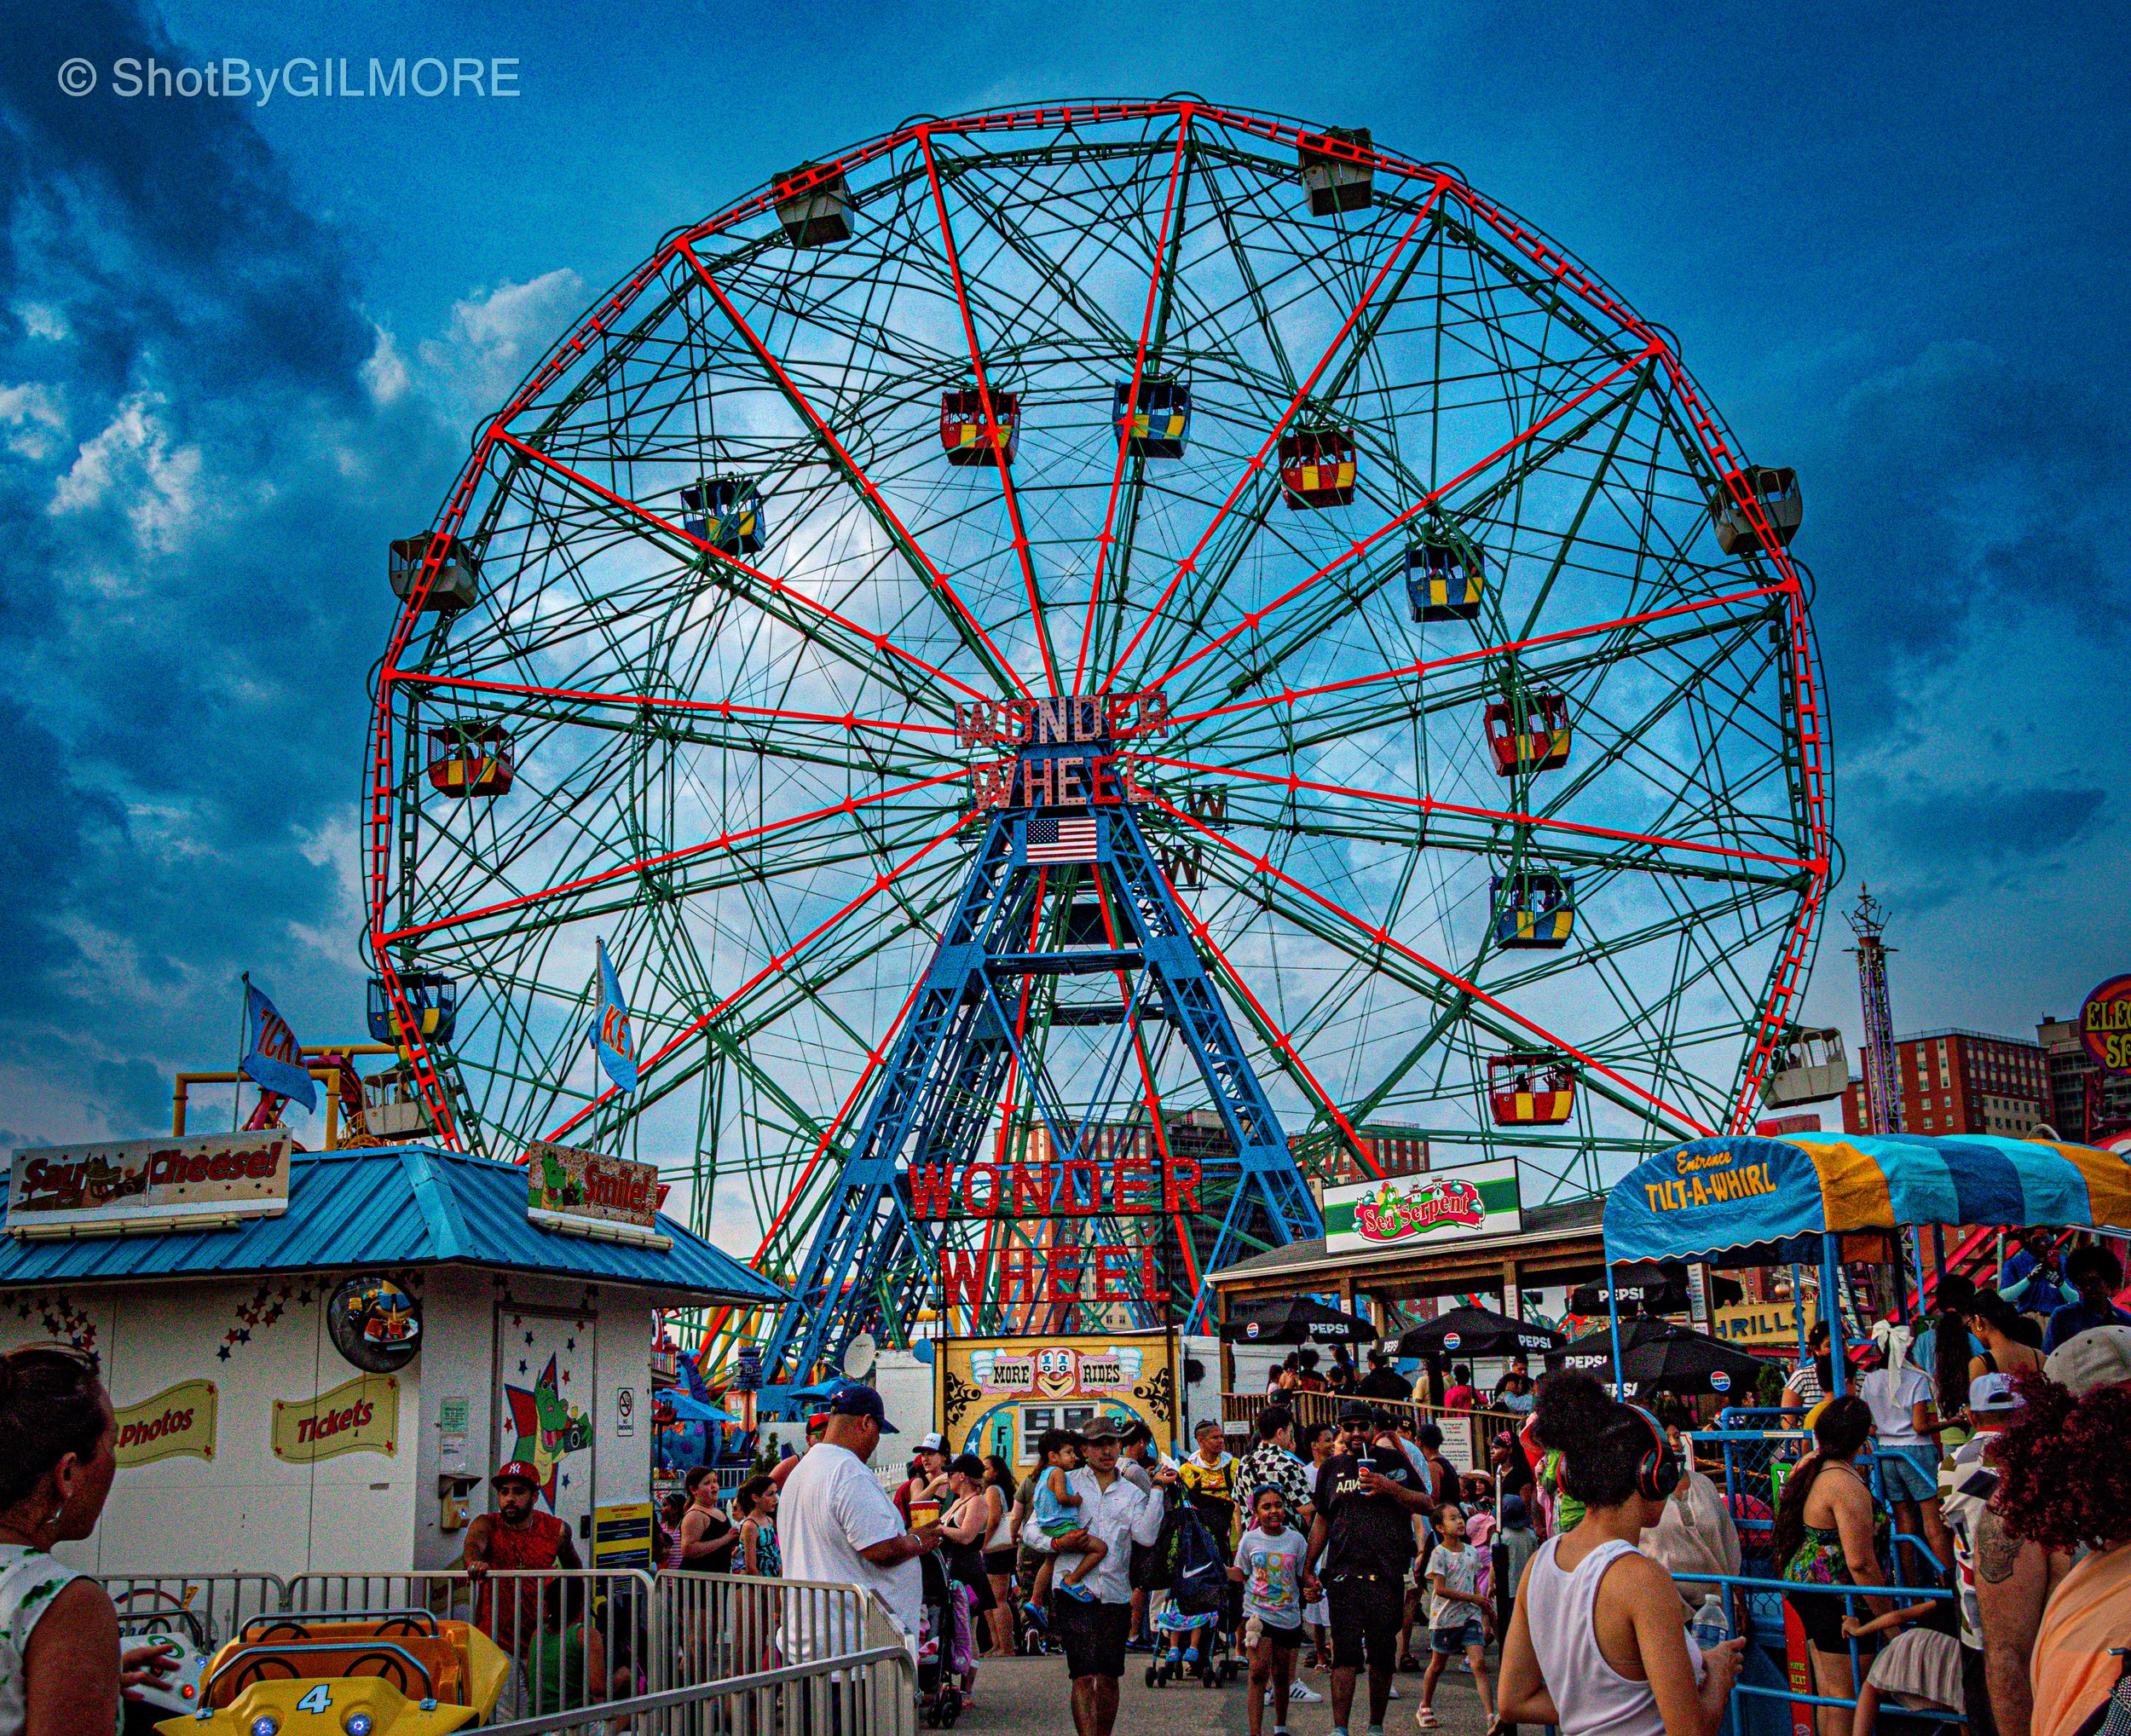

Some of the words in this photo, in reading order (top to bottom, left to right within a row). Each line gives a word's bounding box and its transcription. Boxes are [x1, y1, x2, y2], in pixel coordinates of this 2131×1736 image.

[955, 691, 1168, 748] WONDER
[970, 754, 1156, 810] WHEEL
[20, 1157, 87, 1197] Say
[145, 1141, 283, 1185] Cheese!
[1676, 1151, 1732, 1174] Entrance
[583, 1161, 650, 1213] Smile!
[908, 1156, 1203, 1220] WONDER
[1644, 1162, 1777, 1213] TILT-A-WHIRL
[1364, 1209, 1396, 1232] Sea
[1399, 1191, 1470, 1227] Serpent
[938, 1245, 1171, 1306] WHEEL
[1309, 1324, 1349, 1335] PEPSI
[1518, 1334, 1552, 1349] PEPSI
[993, 1364, 1030, 1384] MORE
[1083, 1364, 1120, 1383] RIDES
[118, 1407, 194, 1448] Photos
[297, 1399, 373, 1444] Tickets
[508, 1462, 521, 1474] NY
[296, 1683, 333, 1715] 4
[1791, 1673, 1806, 1686] NEXT
